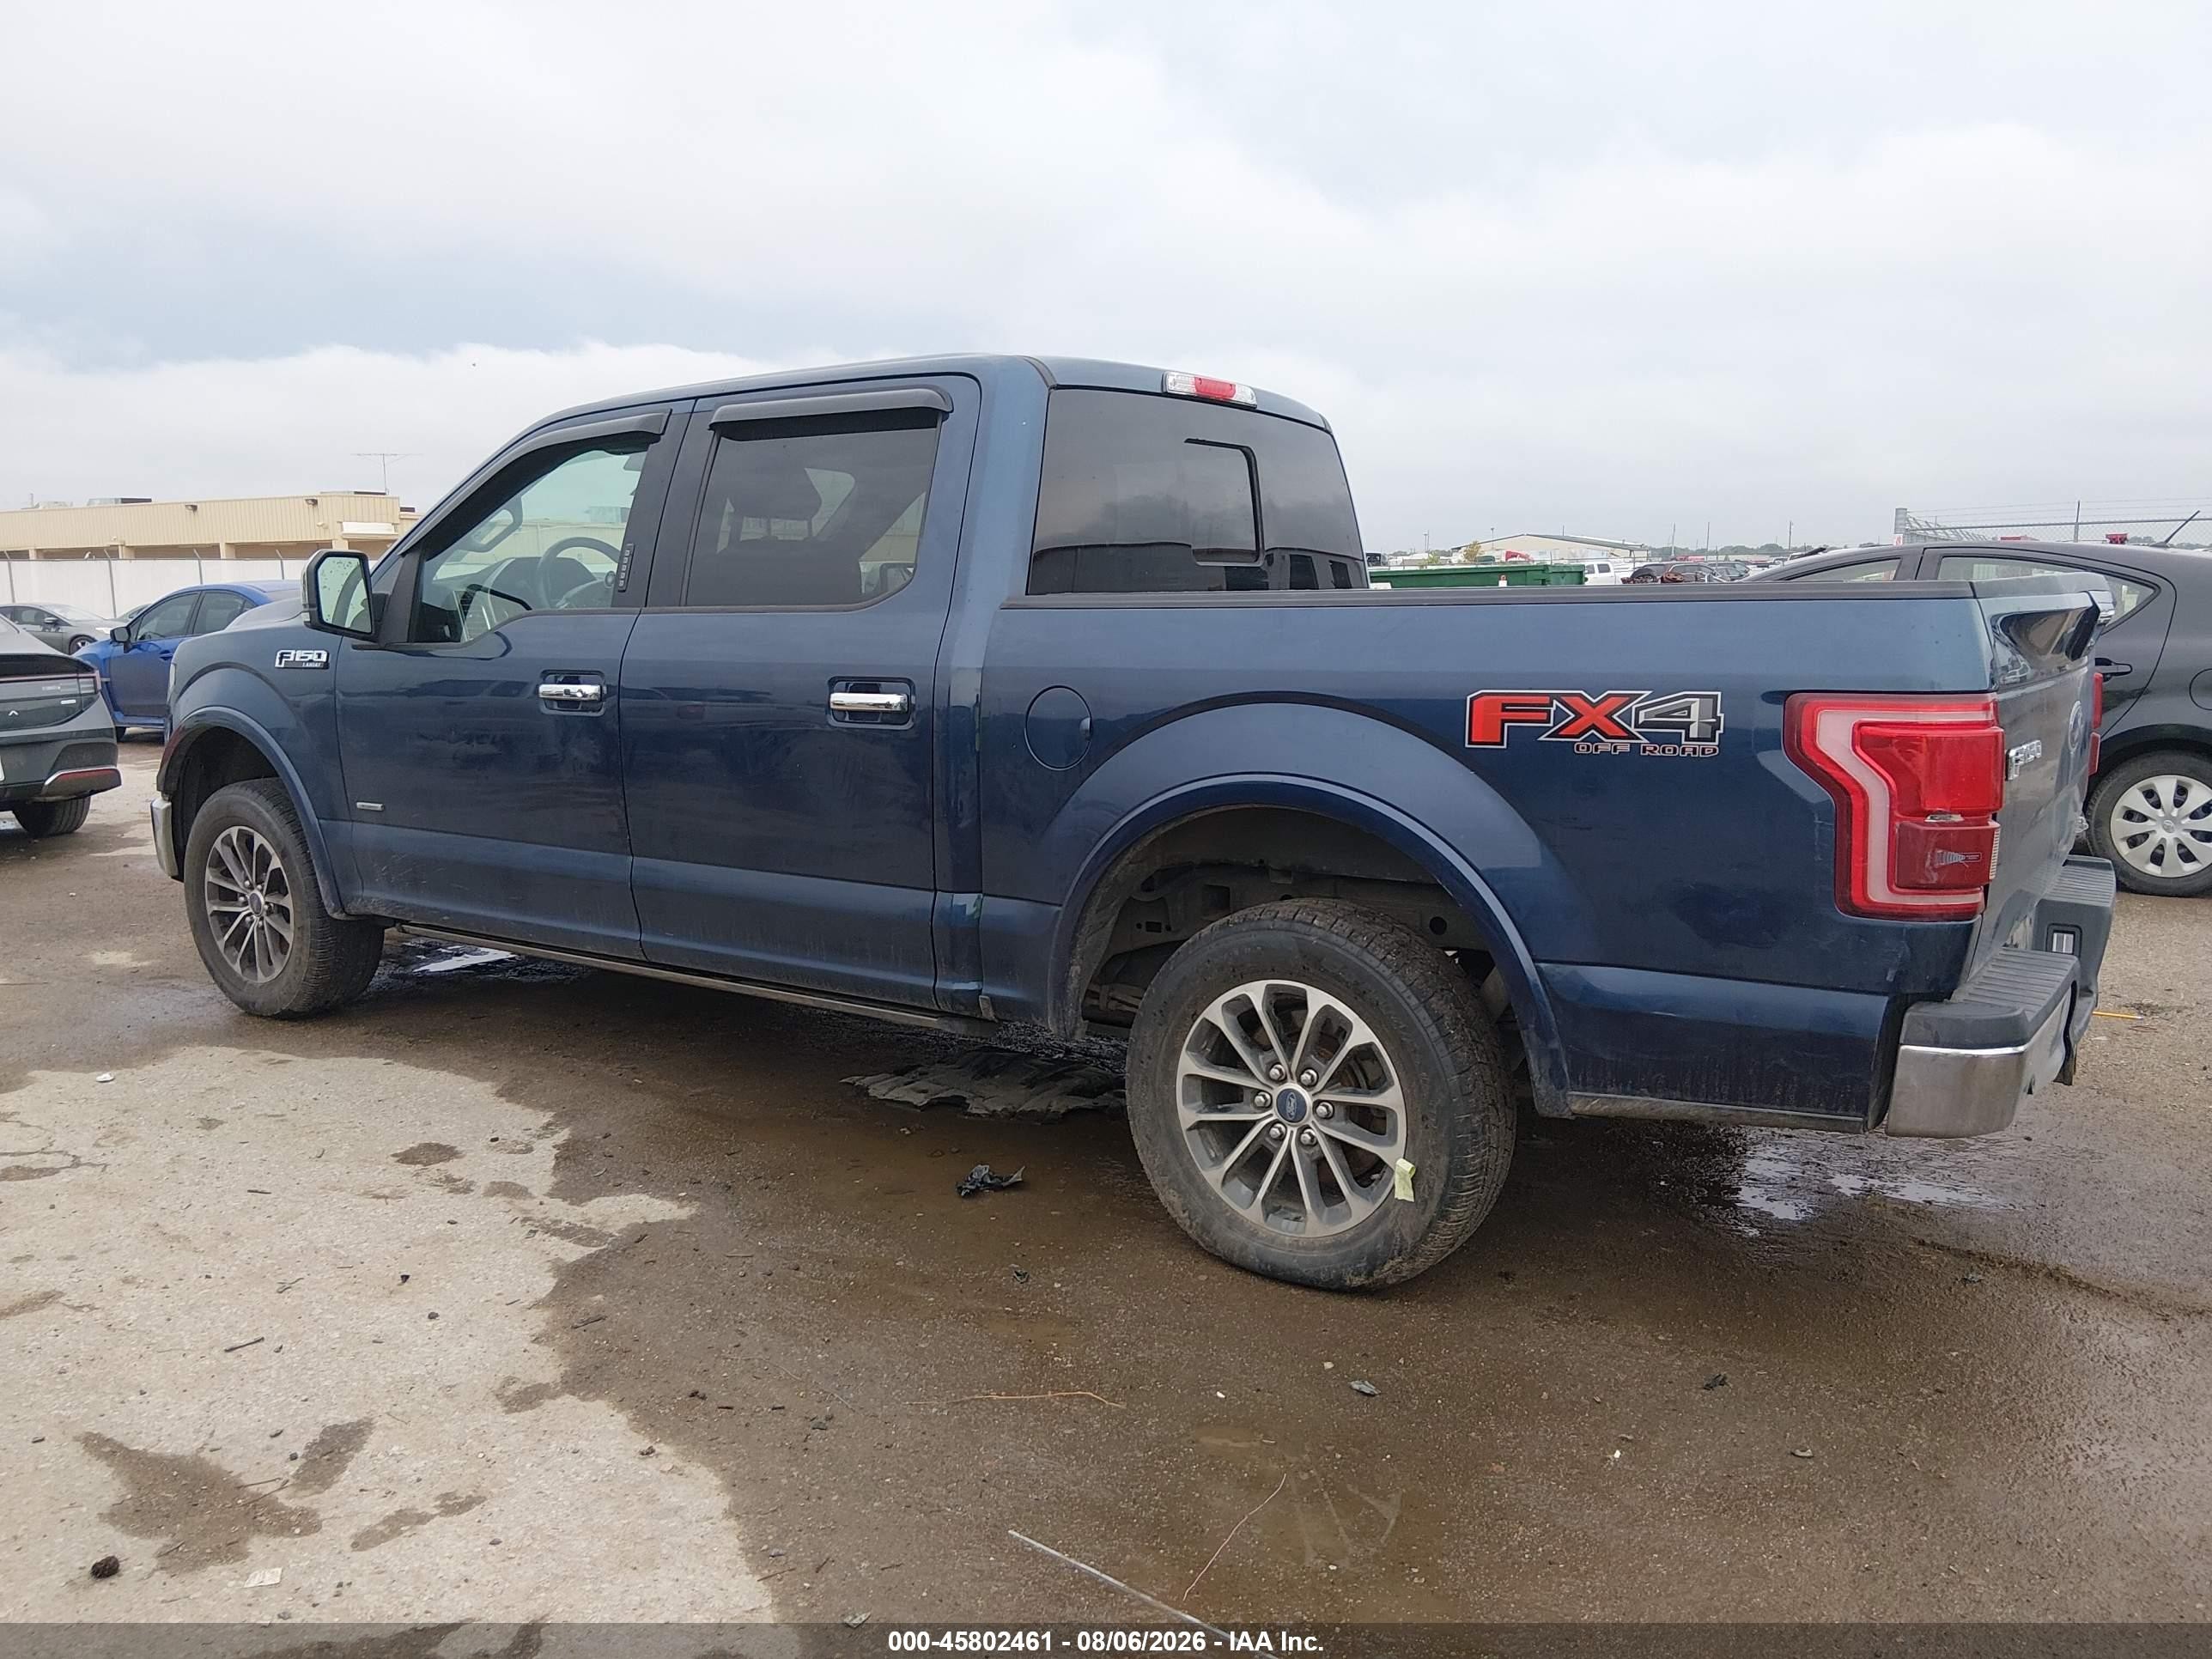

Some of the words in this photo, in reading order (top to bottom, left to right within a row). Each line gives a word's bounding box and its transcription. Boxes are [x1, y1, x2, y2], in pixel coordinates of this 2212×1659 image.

[1465, 690, 1724, 749] FX4
[1574, 742, 1631, 755] OFF
[1640, 743, 1719, 757] ROAD
